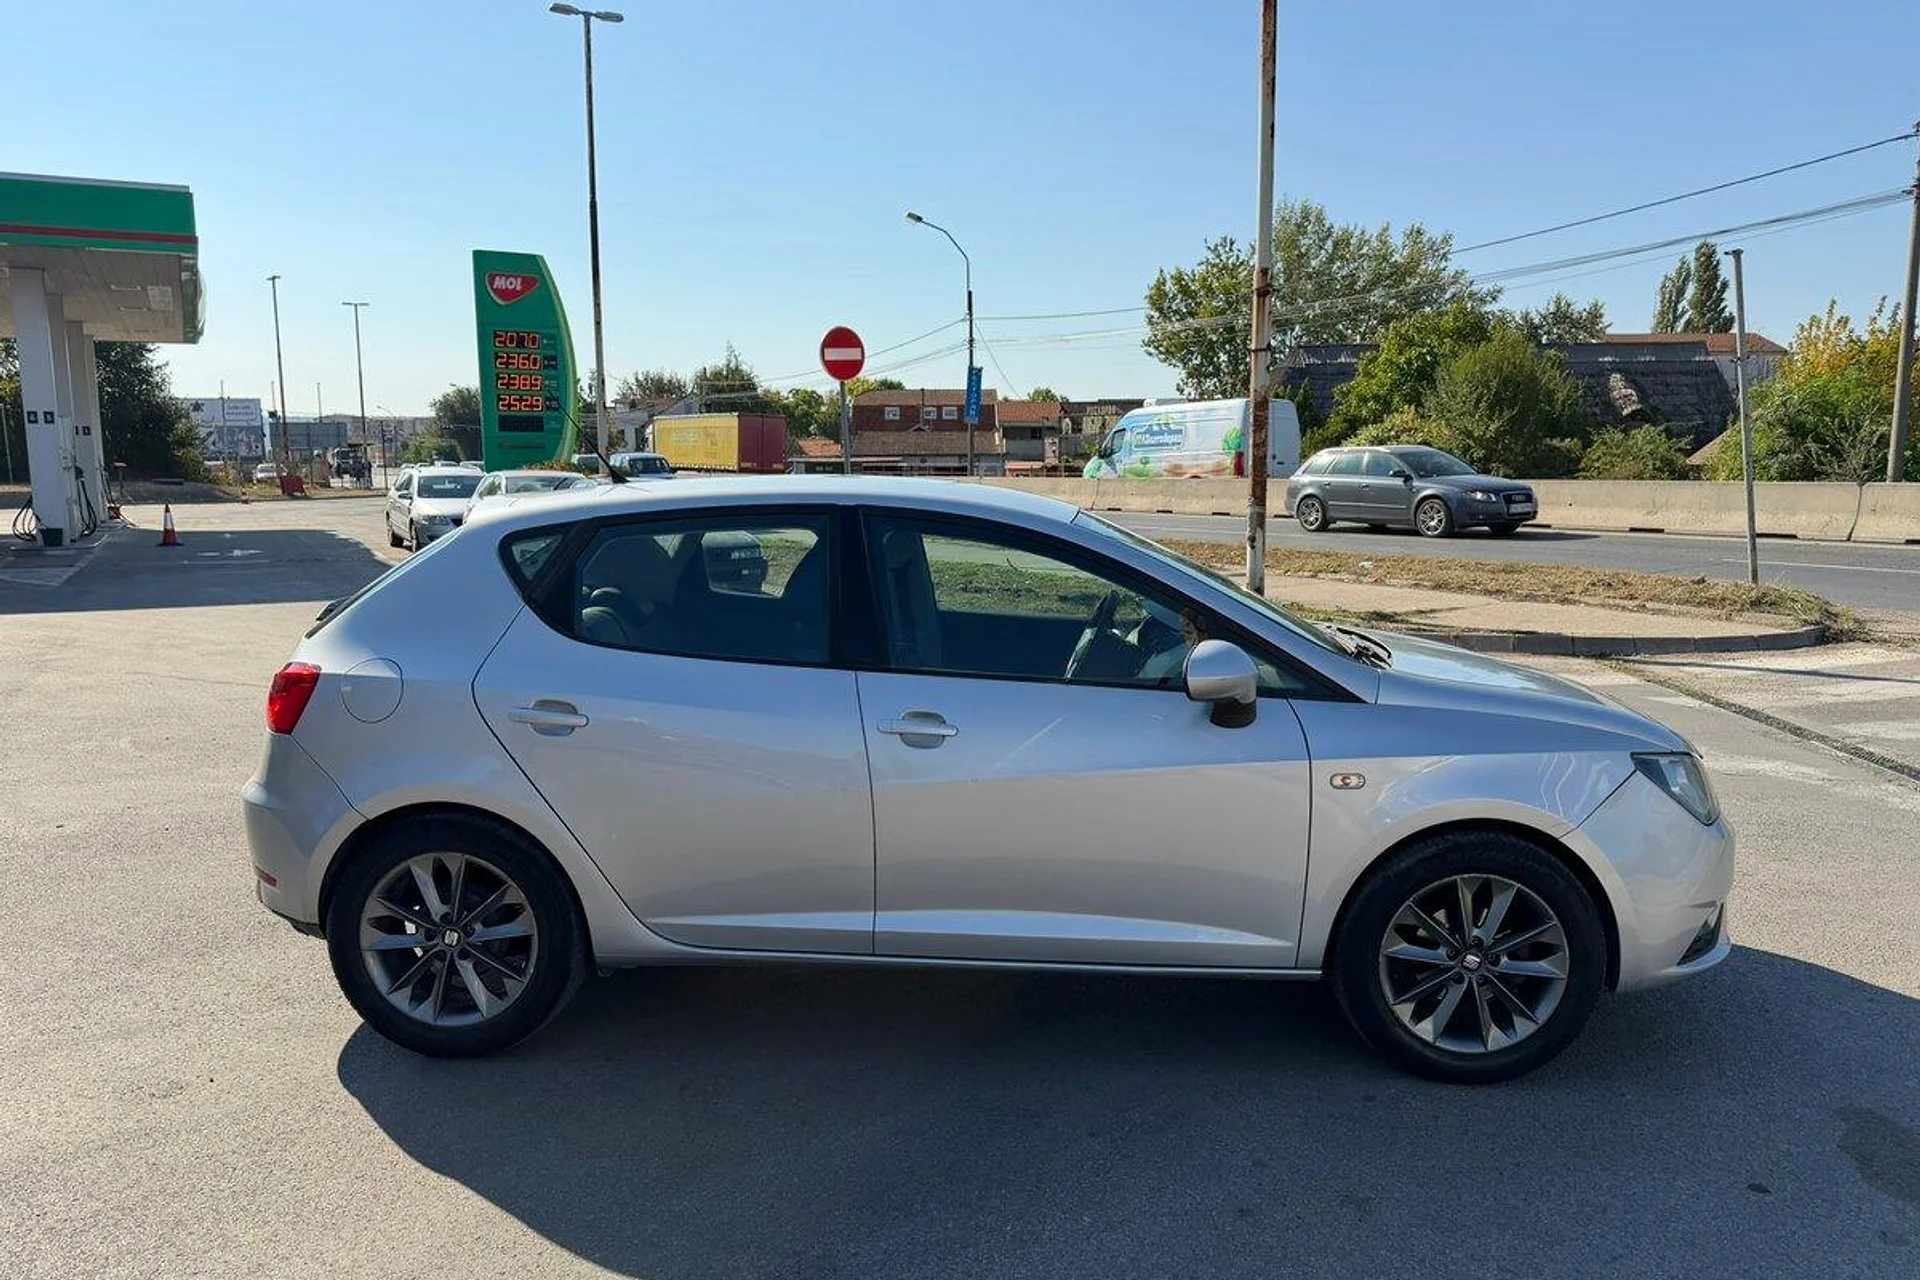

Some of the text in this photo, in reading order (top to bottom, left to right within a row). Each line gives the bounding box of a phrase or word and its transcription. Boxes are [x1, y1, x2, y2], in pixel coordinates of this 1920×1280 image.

[493, 276, 523, 291] MOL
[495, 331, 539, 348] 2070
[498, 395, 543, 411] 2529
